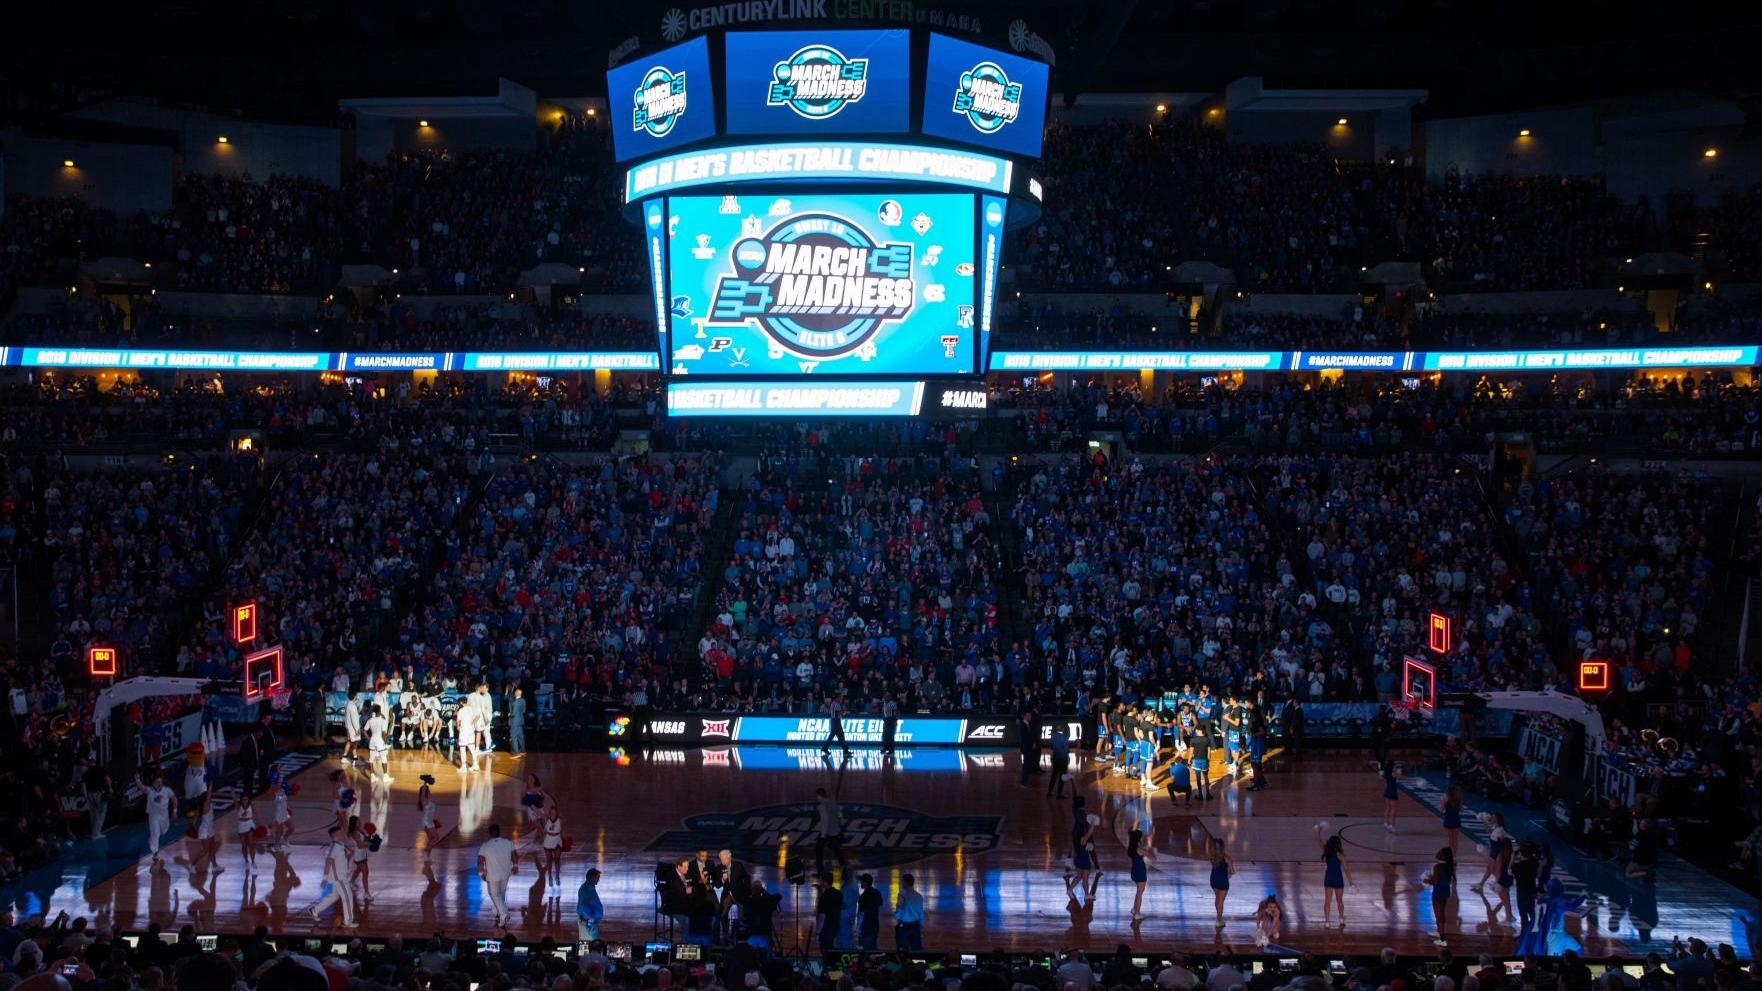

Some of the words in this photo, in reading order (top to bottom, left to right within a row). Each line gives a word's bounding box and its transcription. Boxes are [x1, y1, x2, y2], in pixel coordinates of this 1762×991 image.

[688, 0, 828, 31] CENTURYLINK
[791, 65, 840, 81] MARCH
[797, 80, 863, 97] MADNESS
[971, 78, 1004, 99] MARCH
[729, 147, 854, 176] BASKETBALL
[858, 148, 997, 183] CHAMPIONSHIP
[766, 243, 868, 277] MARCH
[776, 274, 912, 309] MADNESS
[68, 352, 119, 365] DIVISION
[129, 353, 163, 365] MEN'S
[167, 353, 235, 367] BASKETBALL
[237, 354, 318, 368] CHAMPIONSHIP
[354, 356, 435, 367] #MARCHMADNESS
[503, 355, 548, 368] DIVISION
[556, 354, 589, 368] MEN'S
[590, 354, 654, 368] BASKETBALL
[1032, 355, 1079, 367] DIVISION
[1087, 355, 1121, 367] MEN'S
[1123, 354, 1187, 367] BASKETBALL
[1188, 354, 1271, 367] CHAMPIONSHIP
[1308, 355, 1393, 367] #MARCHMADNESS
[1466, 354, 1517, 367] DIVISION
[1526, 353, 1563, 366] MEN'S
[1566, 351, 1640, 365] BASKETBALL
[1643, 349, 1742, 364] CHAMPIONSHIP
[765, 389, 900, 409] CHAMPIONSHIP
[798, 718, 831, 732] NCAA
[968, 725, 1006, 738] ACC
